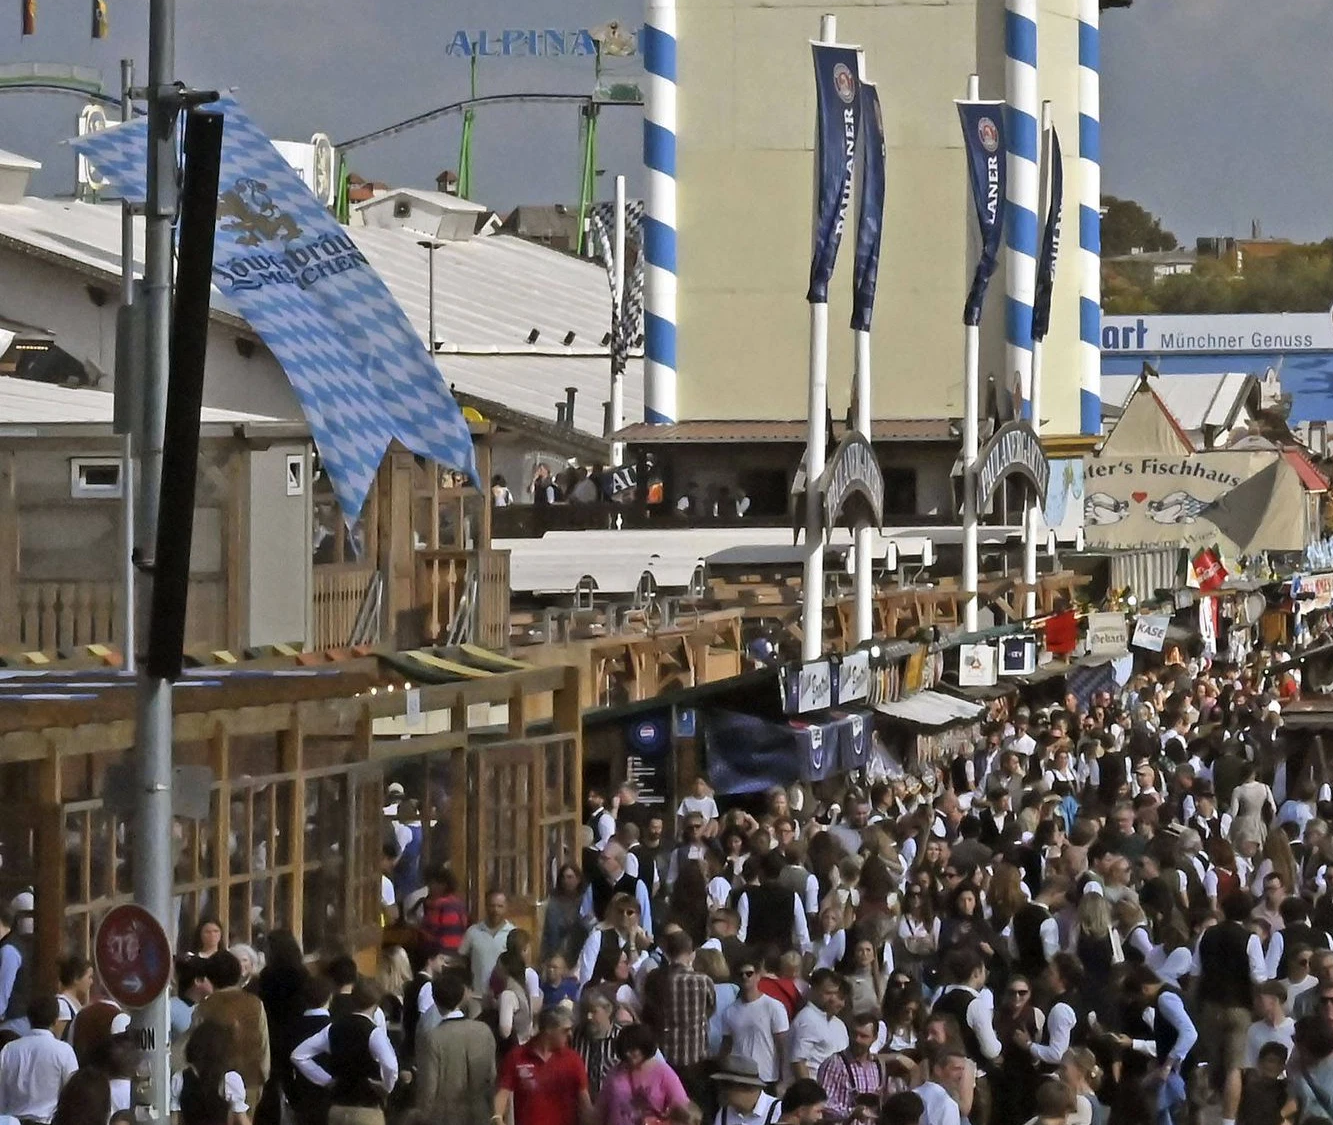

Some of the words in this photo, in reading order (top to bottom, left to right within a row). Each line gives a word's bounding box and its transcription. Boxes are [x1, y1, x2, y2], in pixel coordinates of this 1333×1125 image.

[446, 29, 597, 56] ALPINA
[1160, 332, 1244, 349] Münchner
[1251, 331, 1313, 348] Genuss
[1141, 458, 1241, 487] Fischhaus
